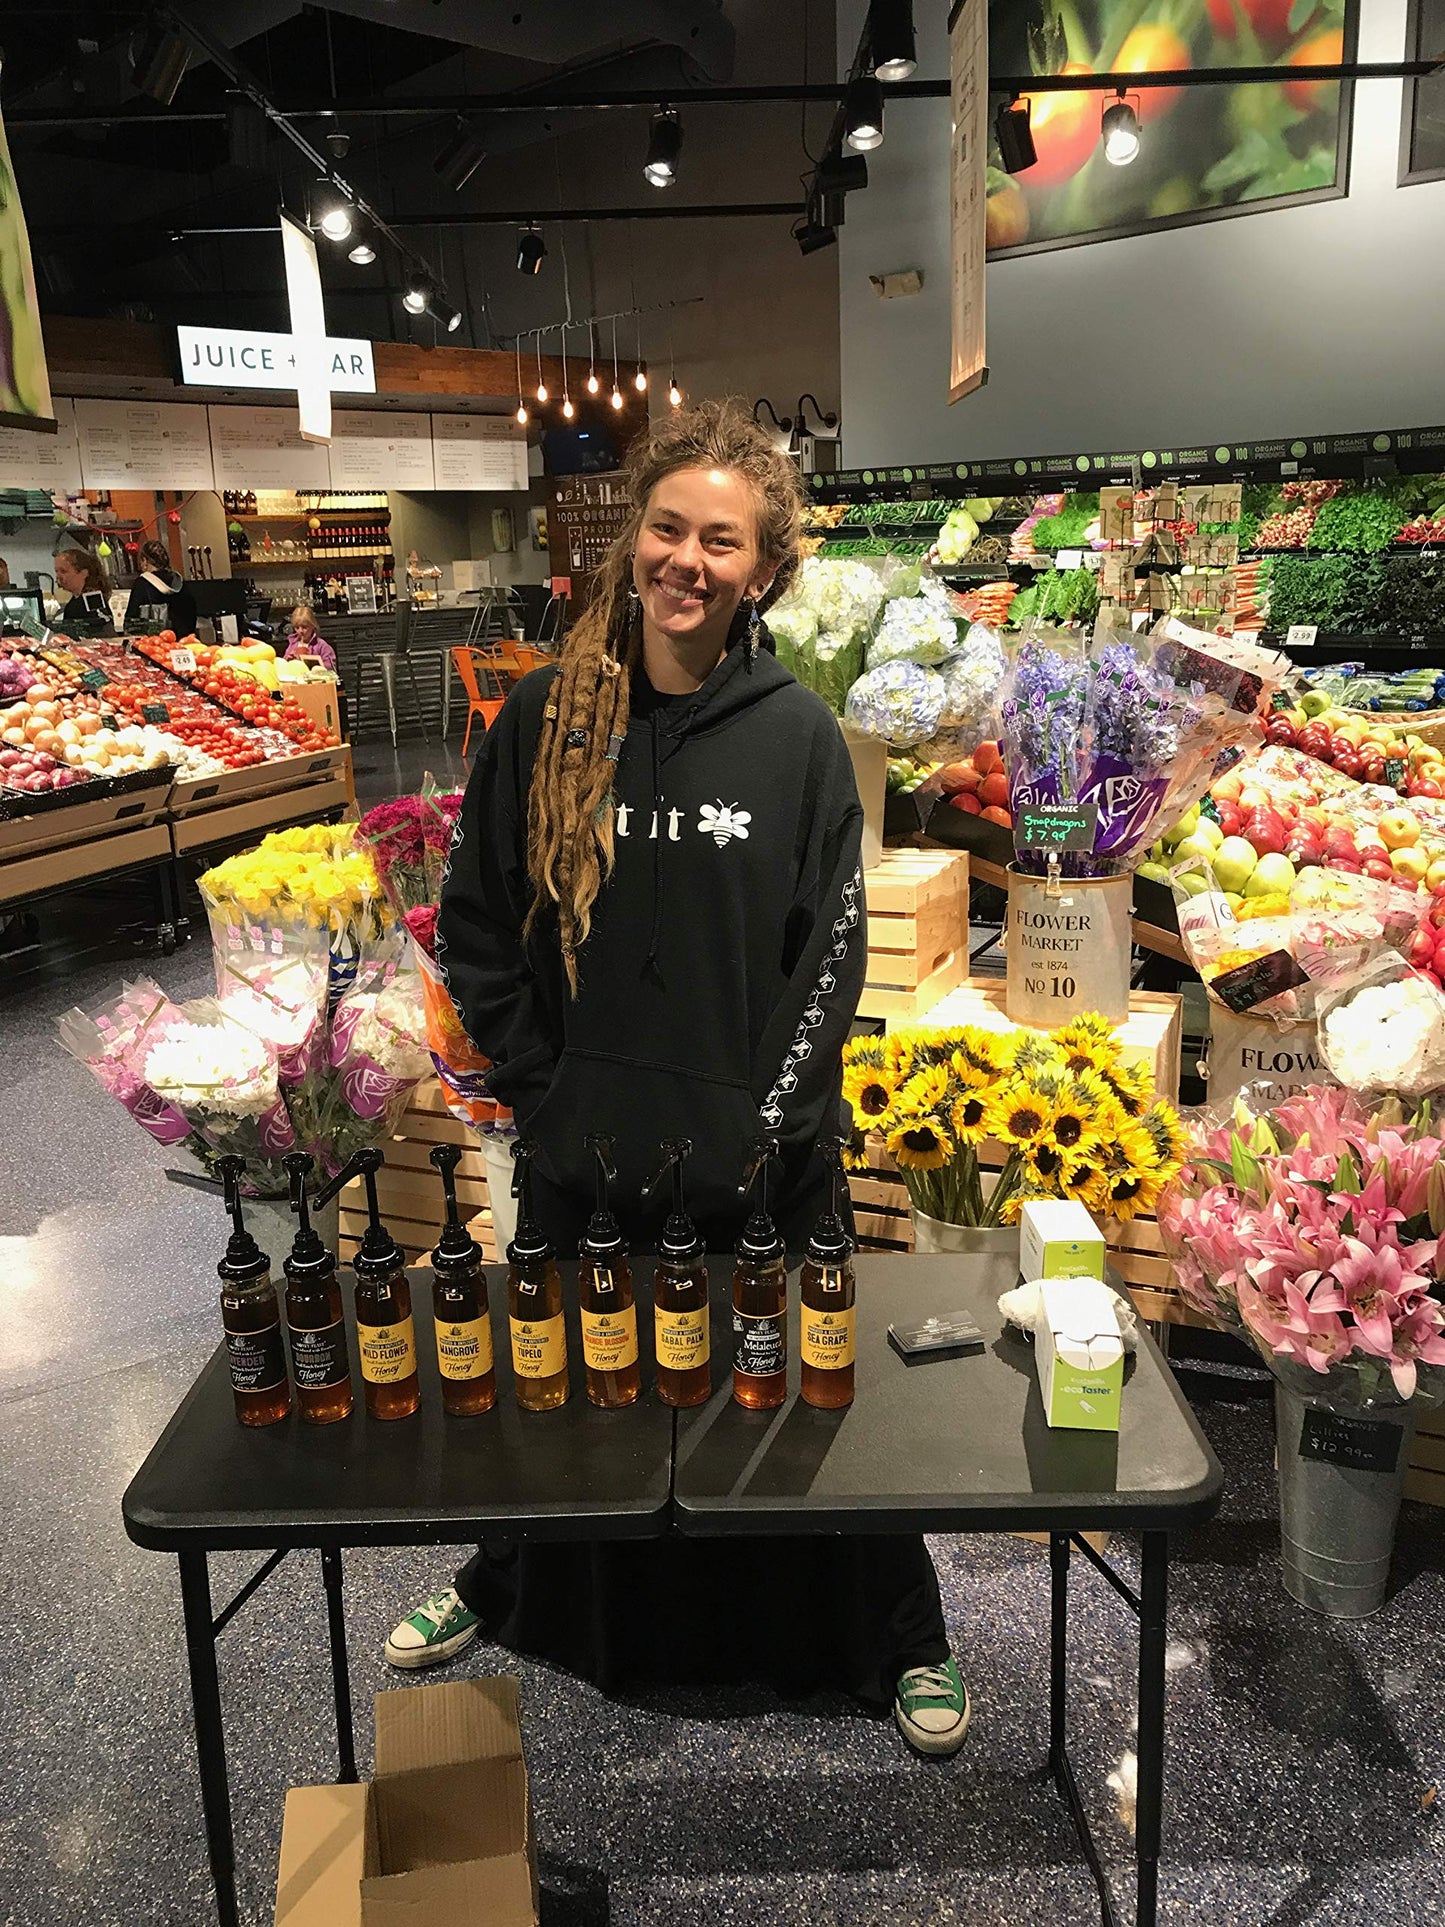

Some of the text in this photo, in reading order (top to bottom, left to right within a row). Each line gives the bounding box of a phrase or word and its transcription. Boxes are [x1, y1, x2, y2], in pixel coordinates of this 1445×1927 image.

[192, 344, 274, 370] JUICE
[331, 354, 365, 375] AR
[1313, 438, 1367, 454] 100 ORGANIC
[1397, 431, 1445, 448] 100 ORGAN
[1235, 444, 1285, 460] 100 ORGANIC
[557, 512, 579, 522] 100%
[584, 525, 620, 534] PRODU
[1040, 805, 1079, 813] ORGANIC
[616, 795, 685, 841] t it
[1024, 815, 1087, 832] Snapdragons
[1016, 910, 1091, 931] FLOWER
[1021, 934, 1083, 952] MARKET
[1031, 960, 1068, 971] est 1874
[1230, 958, 1268, 979] ORGANIC
[1050, 977, 1076, 998] 10
[1241, 1048, 1329, 1072] FLOW
[1251, 1083, 1309, 1101] MAR
[661, 1332, 704, 1346] SABAL PALM
[743, 1339, 782, 1351] Melaleuca
[807, 1331, 848, 1346] SEA GRAPE
[363, 1344, 409, 1359] WILD FLOWER
[440, 1344, 480, 1357] MANGROVE
[518, 1347, 542, 1359] TUPELO
[592, 1351, 619, 1363] Honey
[667, 1350, 697, 1363] Honey
[811, 1351, 840, 1363] Honey
[445, 1361, 472, 1373] Honey
[519, 1361, 541, 1373] Honey
[747, 1356, 777, 1368] Honey
[299, 1368, 327, 1381] Honey
[371, 1364, 400, 1377] Honey
[232, 1371, 259, 1384] Honey
[1063, 1386, 1112, 1395] ecoTaster
